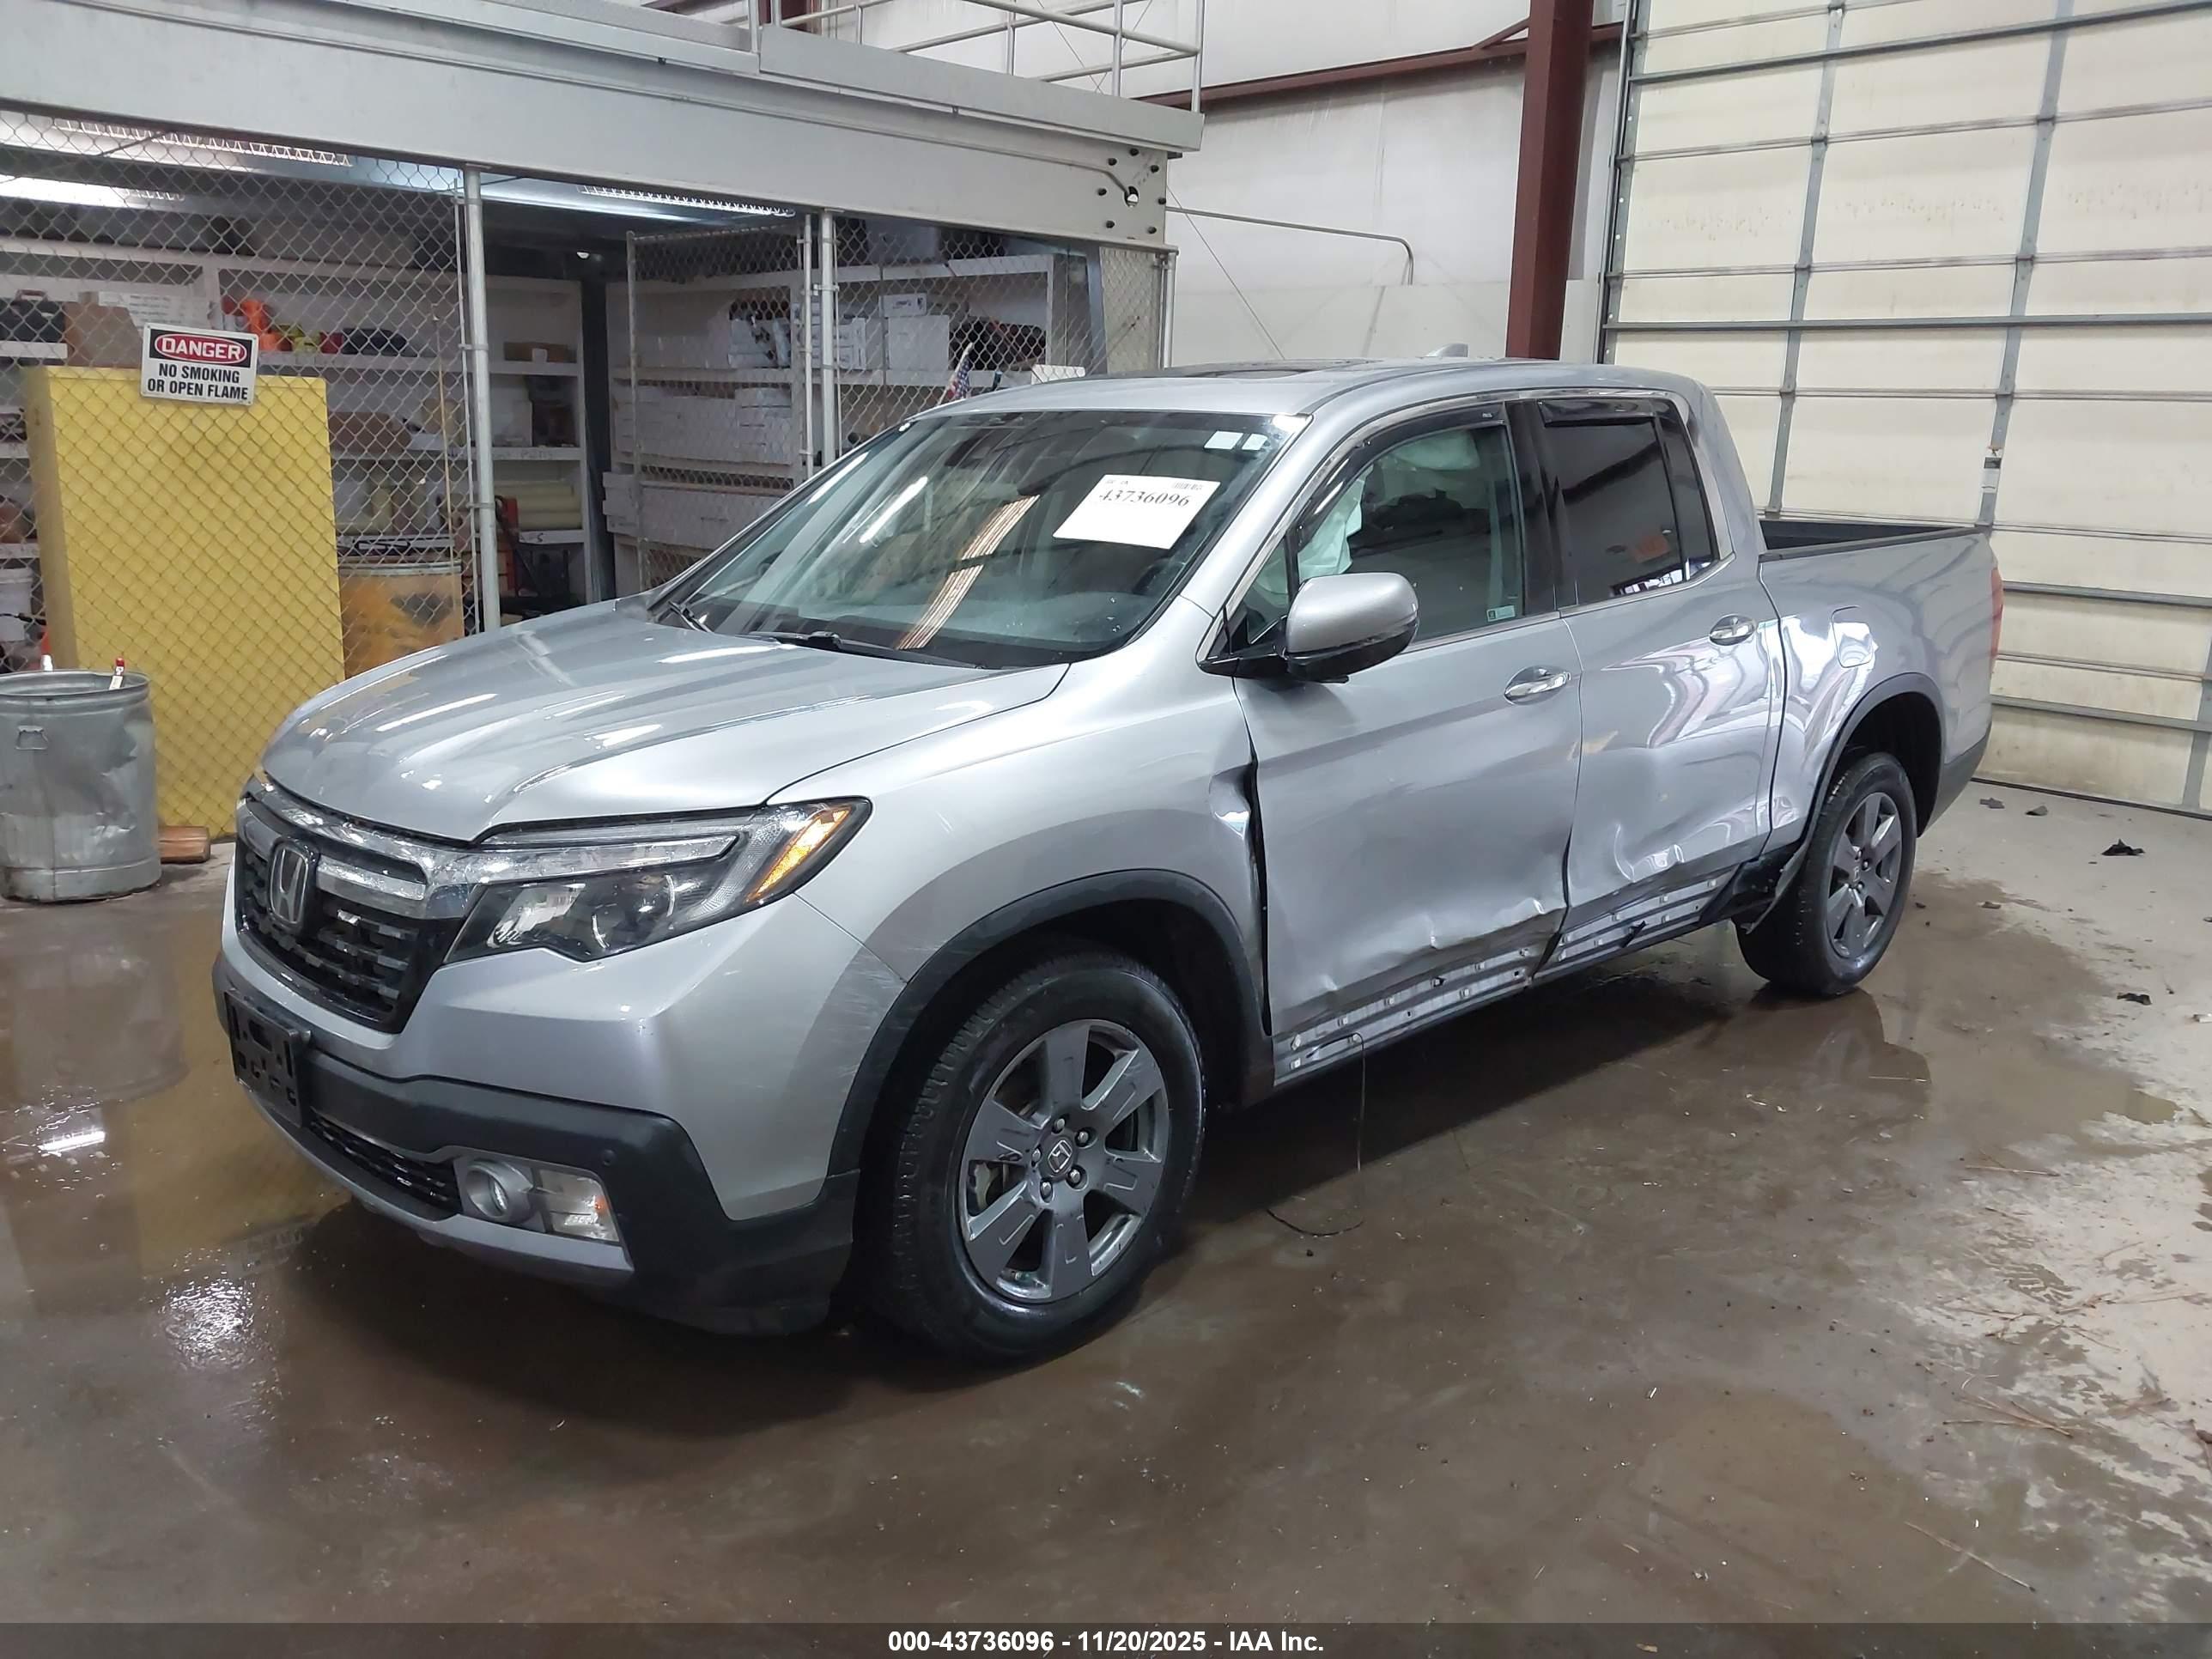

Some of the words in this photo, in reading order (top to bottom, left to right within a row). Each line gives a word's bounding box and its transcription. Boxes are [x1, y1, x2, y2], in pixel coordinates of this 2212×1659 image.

[161, 337, 241, 360] DANGER
[159, 362, 177, 378] NO
[181, 365, 240, 384] SMOKING
[148, 378, 165, 392] OR
[169, 380, 204, 396] OPEN
[207, 384, 248, 400] FLAME
[1099, 489, 1191, 507] 43736096
